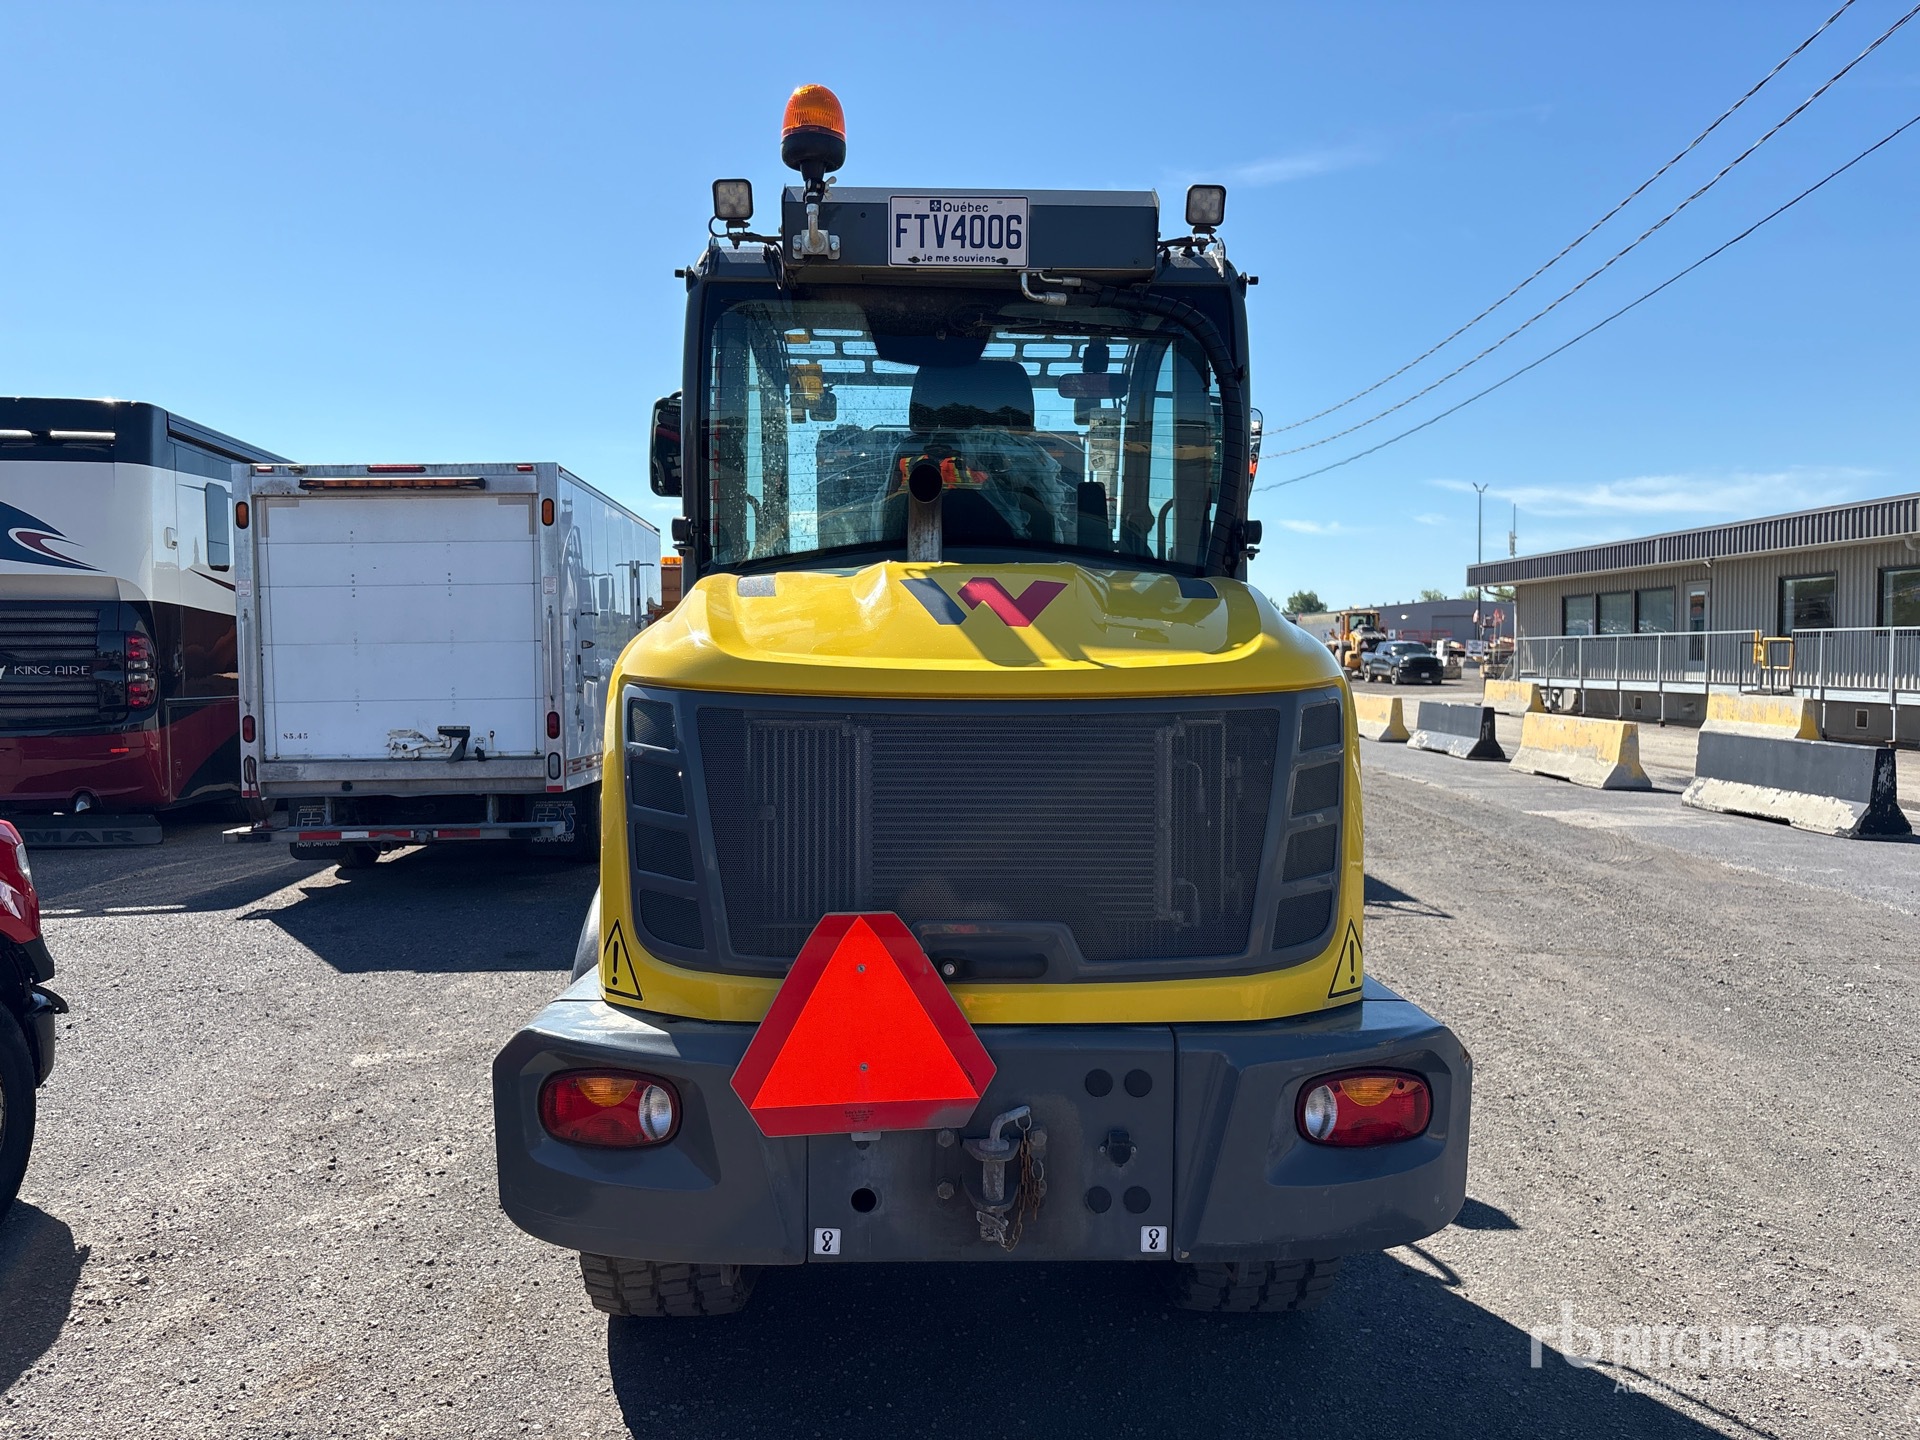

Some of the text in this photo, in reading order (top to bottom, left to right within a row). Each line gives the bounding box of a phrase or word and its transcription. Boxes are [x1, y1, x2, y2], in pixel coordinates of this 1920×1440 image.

[943, 201, 989, 213] Québec
[895, 213, 1022, 249] FTV4006
[921, 253, 996, 263] Je me souviens
[14, 665, 91, 675] KING AIRE
[24, 830, 135, 843] MAR
